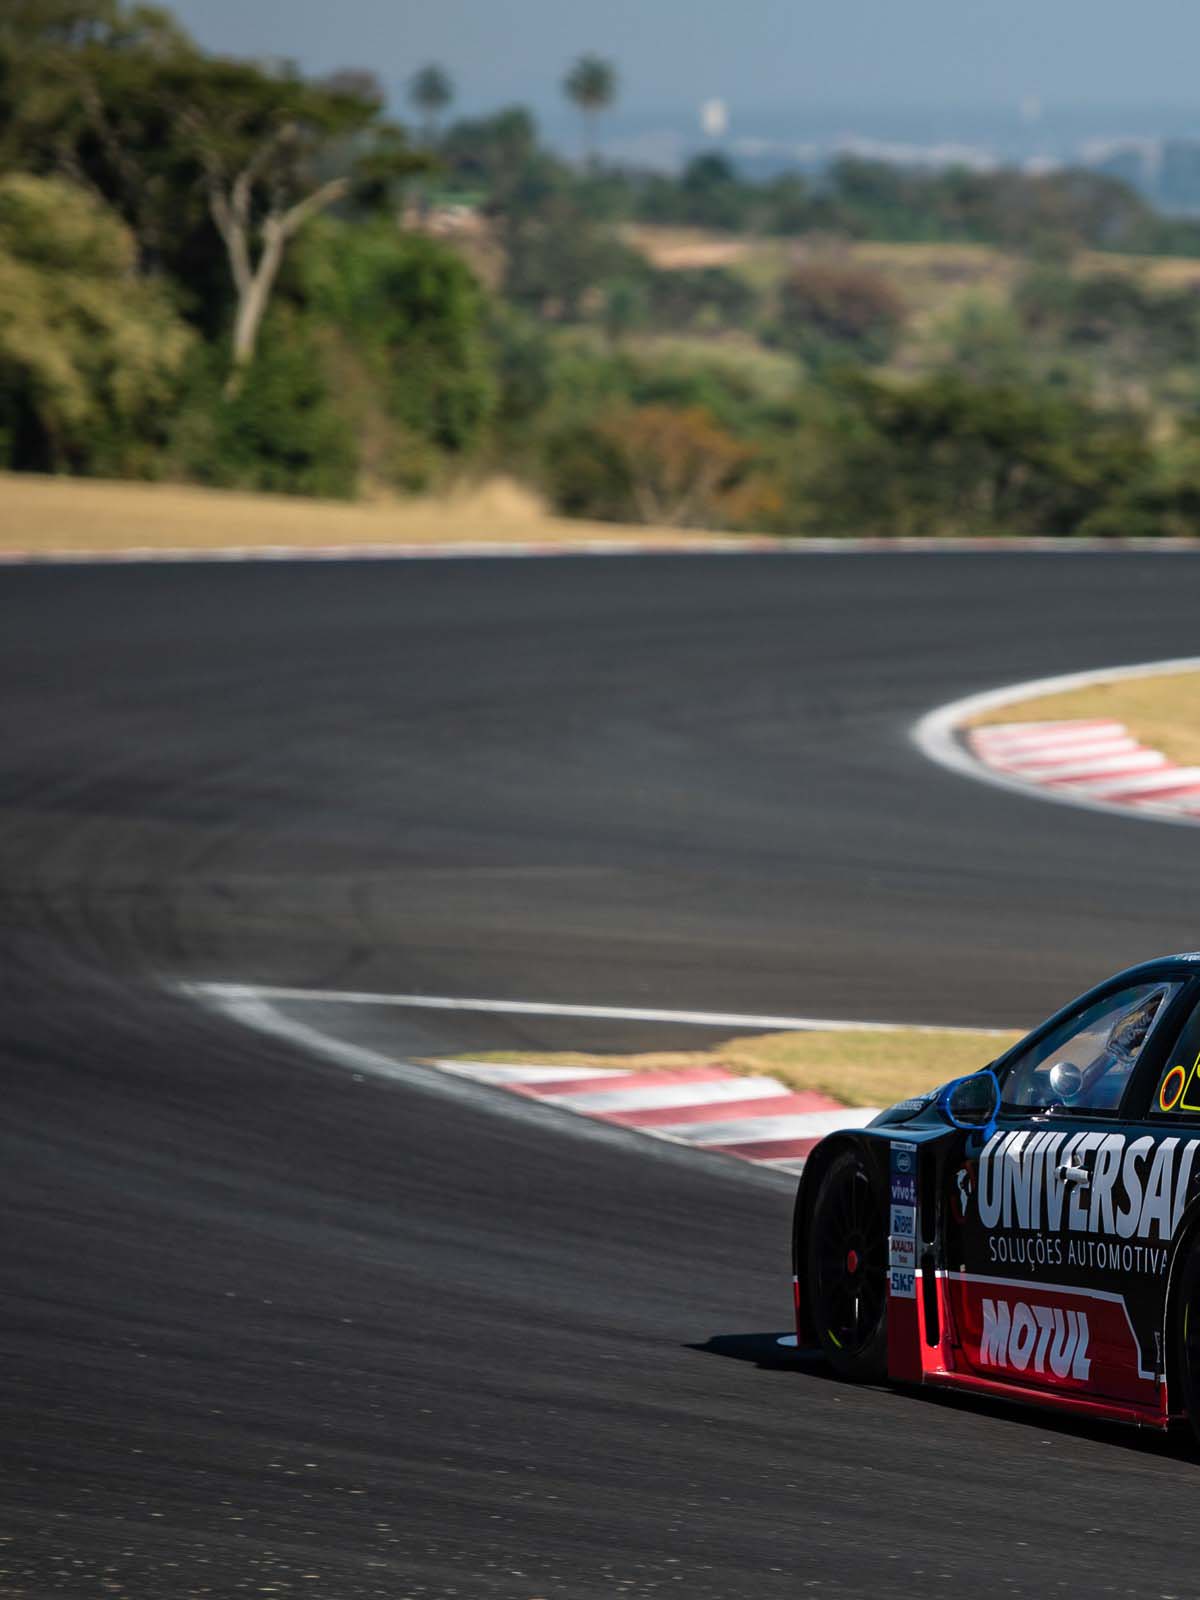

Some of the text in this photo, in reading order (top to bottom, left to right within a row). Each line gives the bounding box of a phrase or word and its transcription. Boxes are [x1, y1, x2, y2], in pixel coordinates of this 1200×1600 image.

[989, 1232, 1062, 1272] SOLUÇÕES
[891, 1272, 914, 1292] SKF
[980, 1298, 1092, 1381] MOTUL
